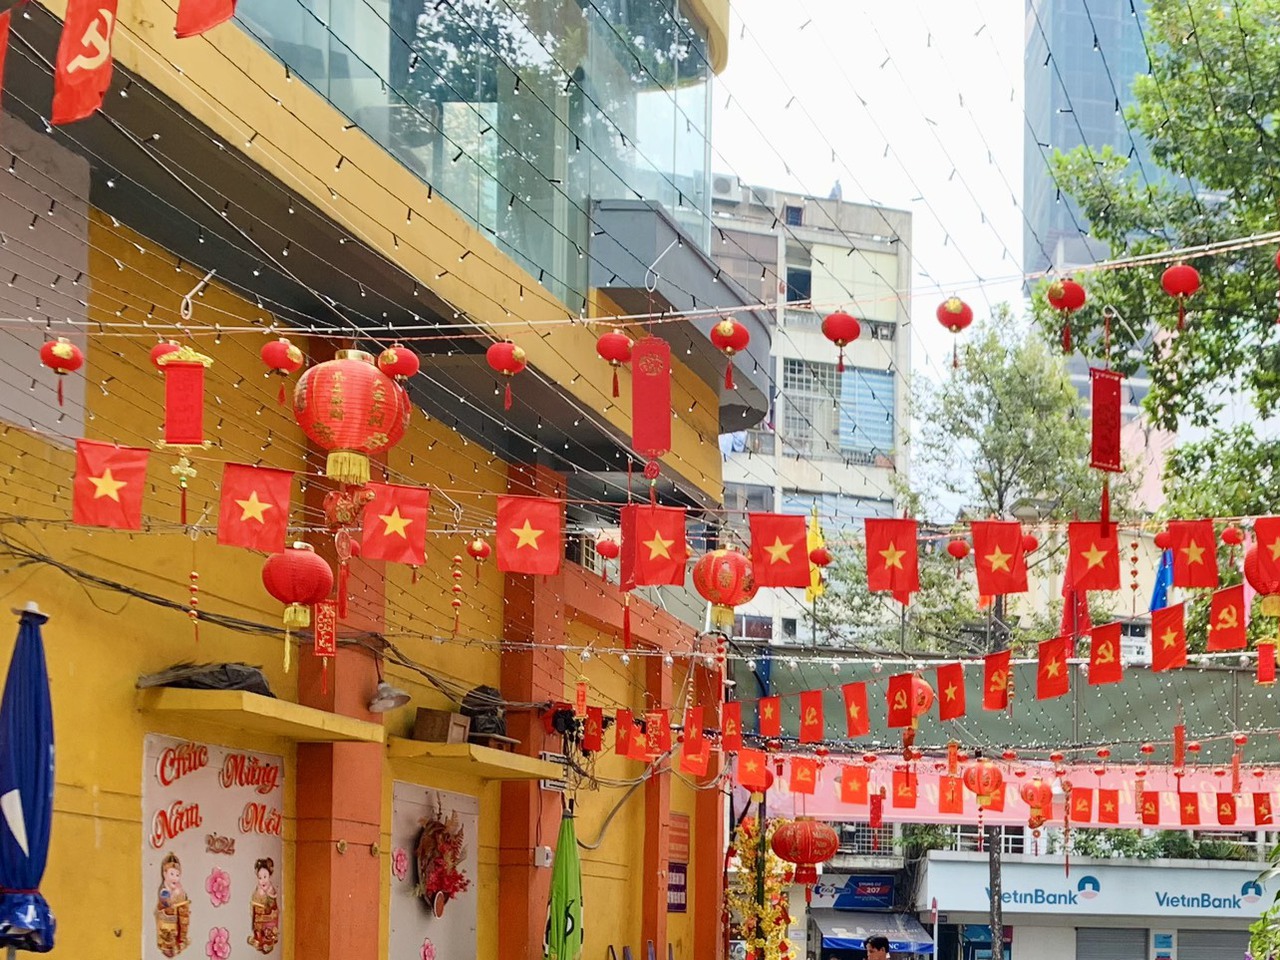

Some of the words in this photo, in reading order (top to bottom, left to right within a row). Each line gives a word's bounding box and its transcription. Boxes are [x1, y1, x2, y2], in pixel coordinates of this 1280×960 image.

[150, 800, 202, 848] Năm
[985, 887, 1078, 906] etinBank
[1155, 891, 1242, 910] VietinBank
